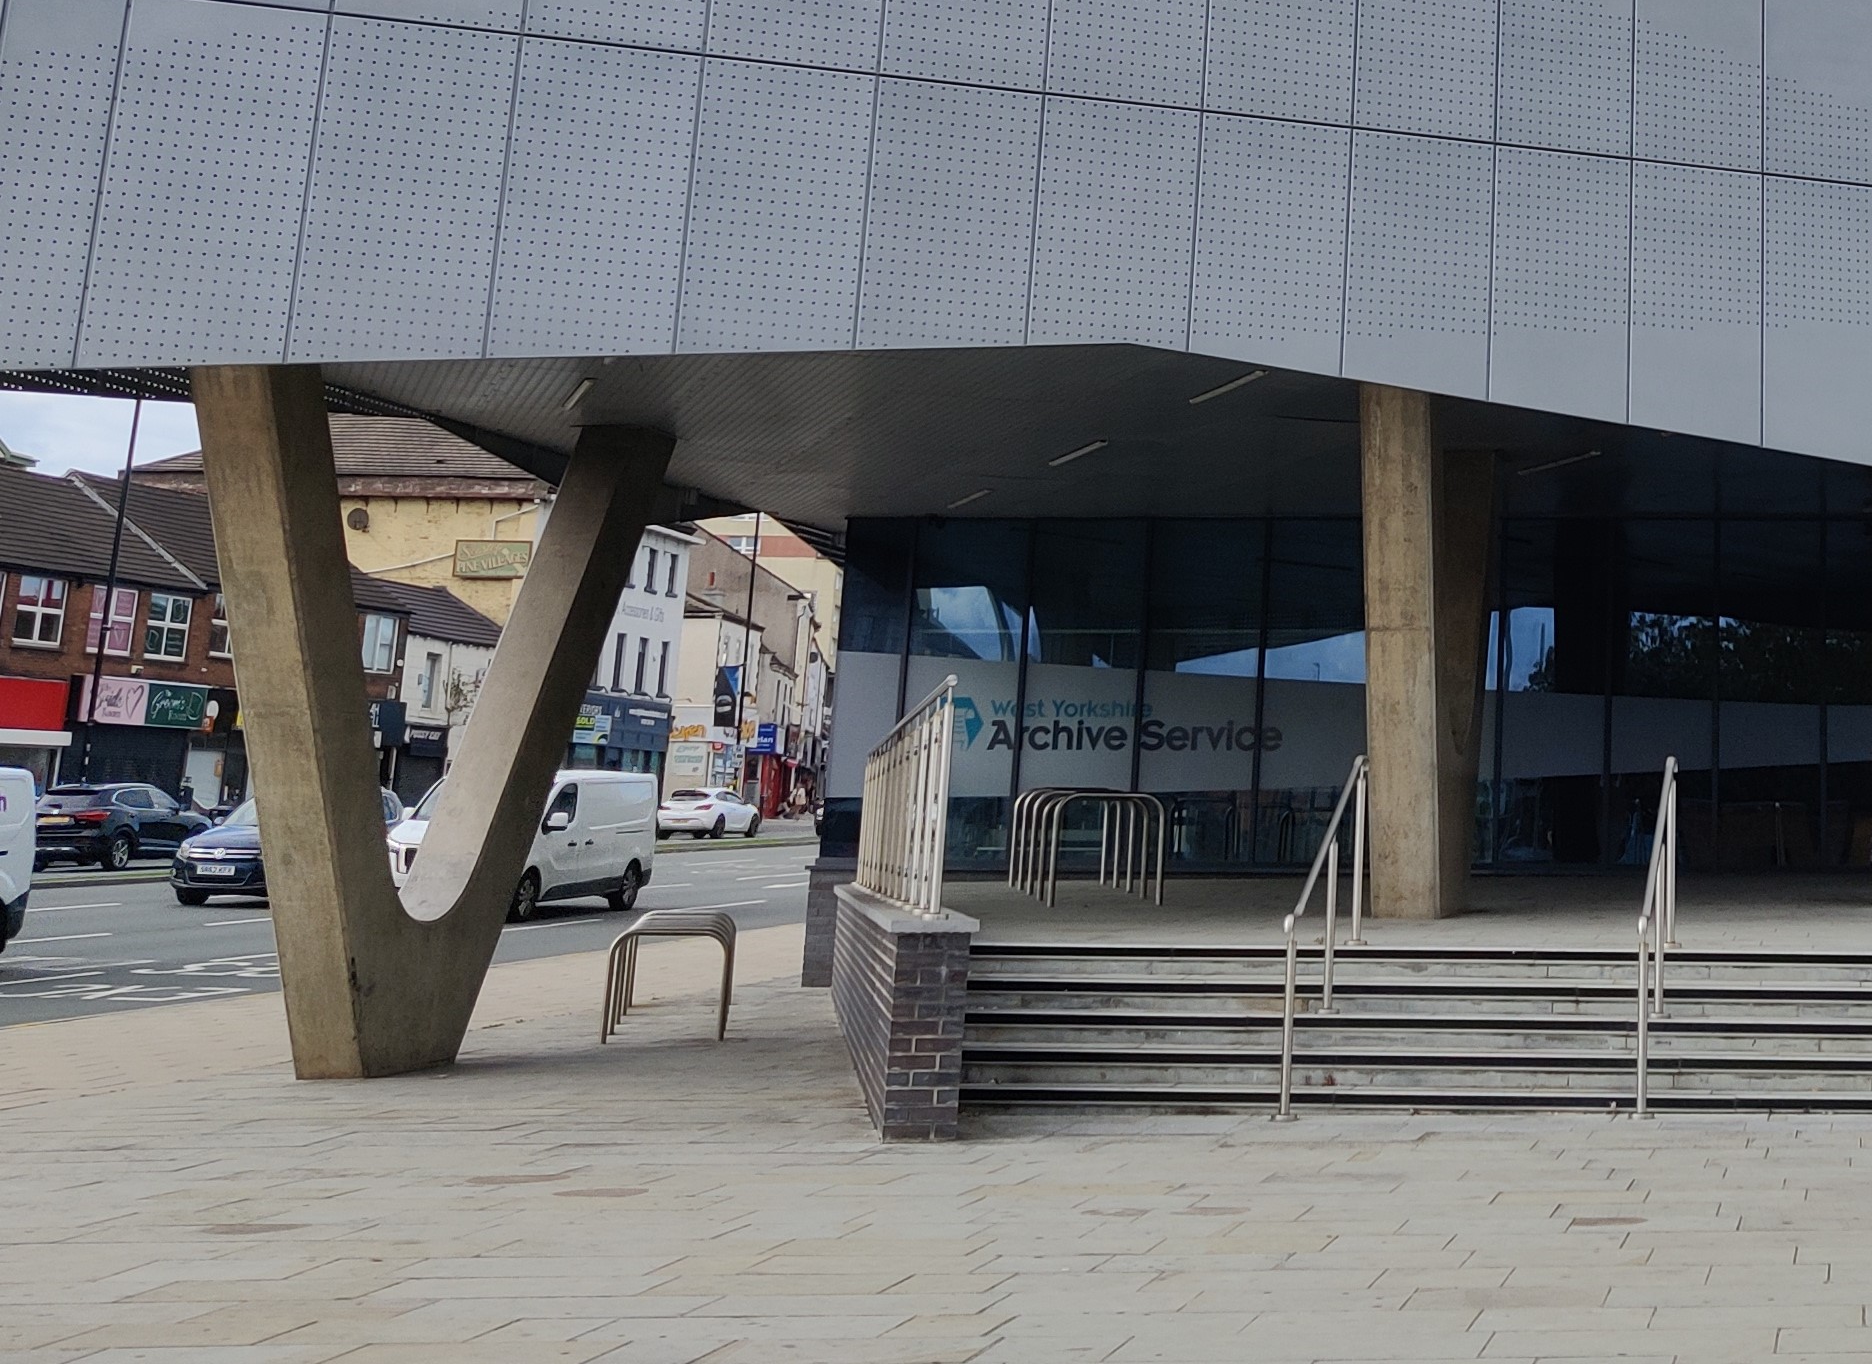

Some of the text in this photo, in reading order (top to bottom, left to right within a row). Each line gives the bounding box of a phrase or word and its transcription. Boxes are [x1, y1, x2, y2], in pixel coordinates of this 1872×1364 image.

[990, 699, 1153, 718] West Yorkshire
[986, 719, 1283, 752] Archive Service
